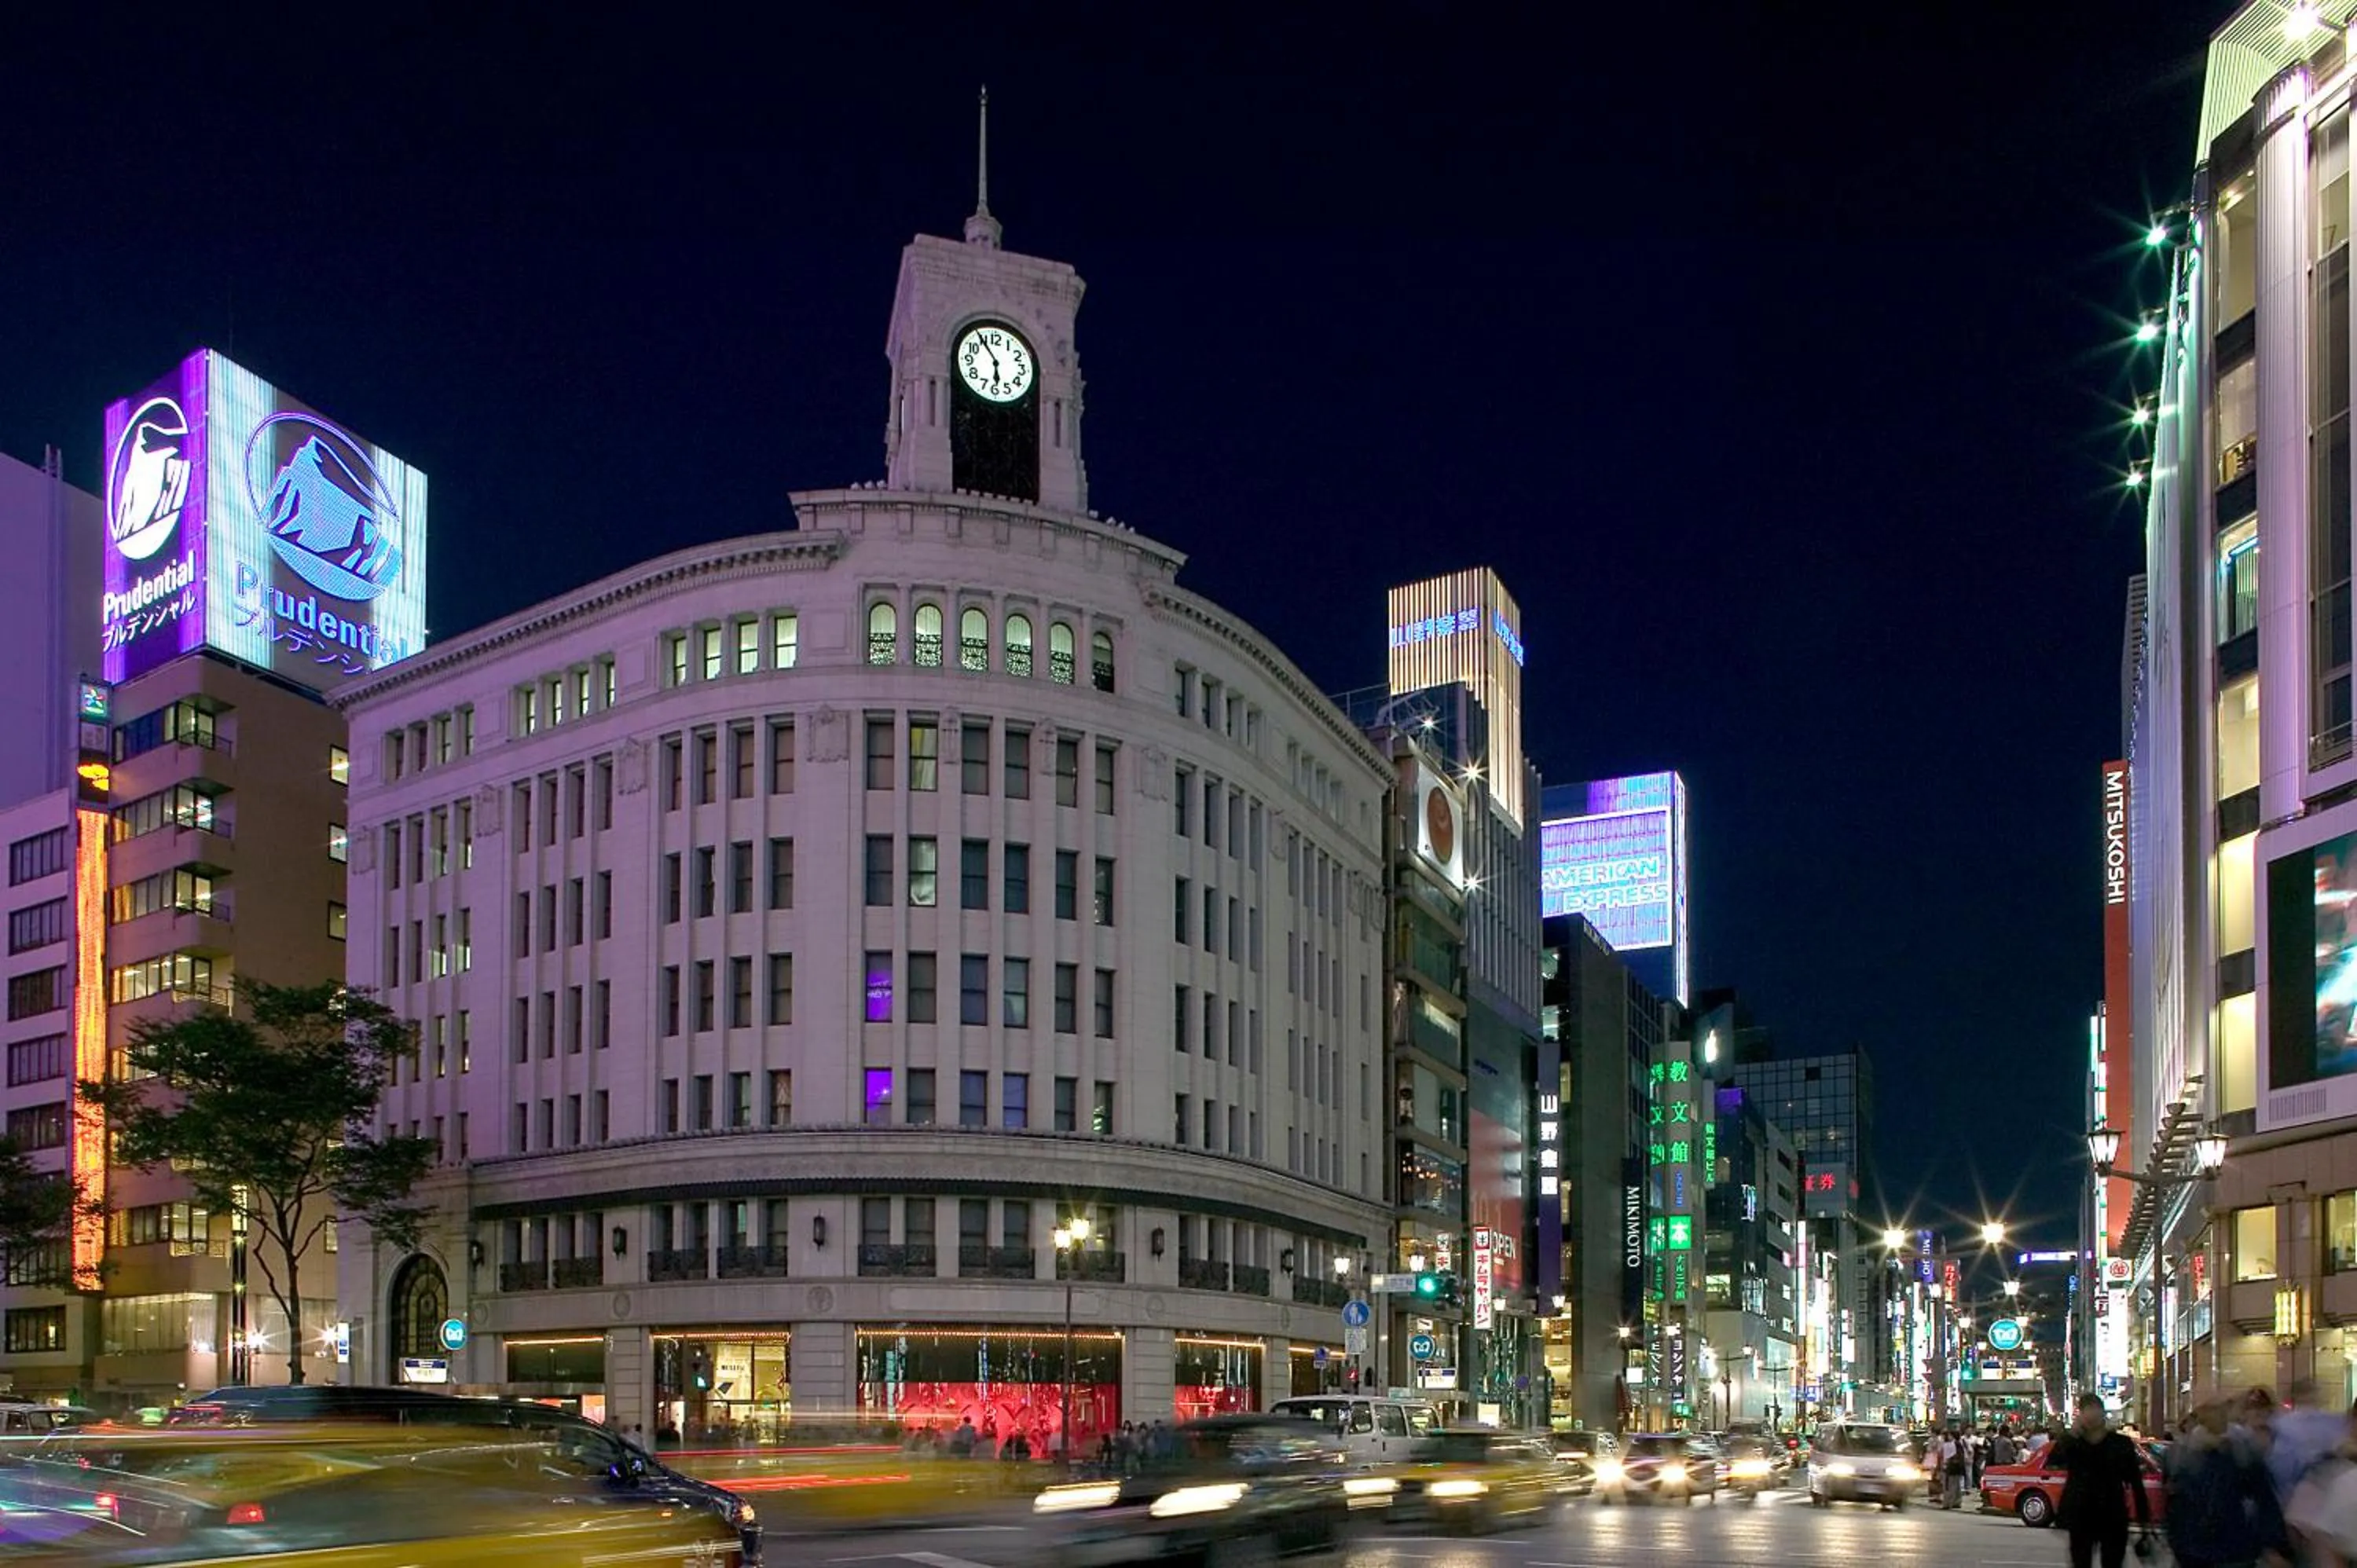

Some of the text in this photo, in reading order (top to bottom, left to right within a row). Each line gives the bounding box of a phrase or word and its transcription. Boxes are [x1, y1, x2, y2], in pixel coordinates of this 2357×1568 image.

[969, 343, 979, 354] 10
[991, 334, 1002, 346] 12
[964, 354, 973, 366] 9
[1014, 350, 1022, 361] 2
[1017, 364, 1026, 376] 3
[969, 367, 978, 379] 8
[980, 379, 988, 390] 7
[1013, 376, 1022, 387] 4
[991, 384, 999, 394] 6
[1003, 383, 1011, 394] 5
[103, 549, 194, 625] Prudential
[101, 590, 196, 652] プルデンシャル
[236, 561, 409, 663] Prudential
[234, 603, 366, 674] プルデンシ
[2106, 771, 2124, 904] MITSUKOSHI
[1542, 856, 1660, 889] AMERICAN
[1563, 882, 1669, 912] EXPRESS
[1670, 1061, 1688, 1163] 教文館
[1627, 1185, 1640, 1267] MIKIMOTO
[1671, 1221, 1688, 1245] 本
[1492, 1231, 1516, 1260] OPEN
[1923, 1238, 1931, 1276] MIHO
[1476, 1254, 1490, 1324] キムラヤのパン
[1673, 1340, 1684, 1386] ヨシノヤ
